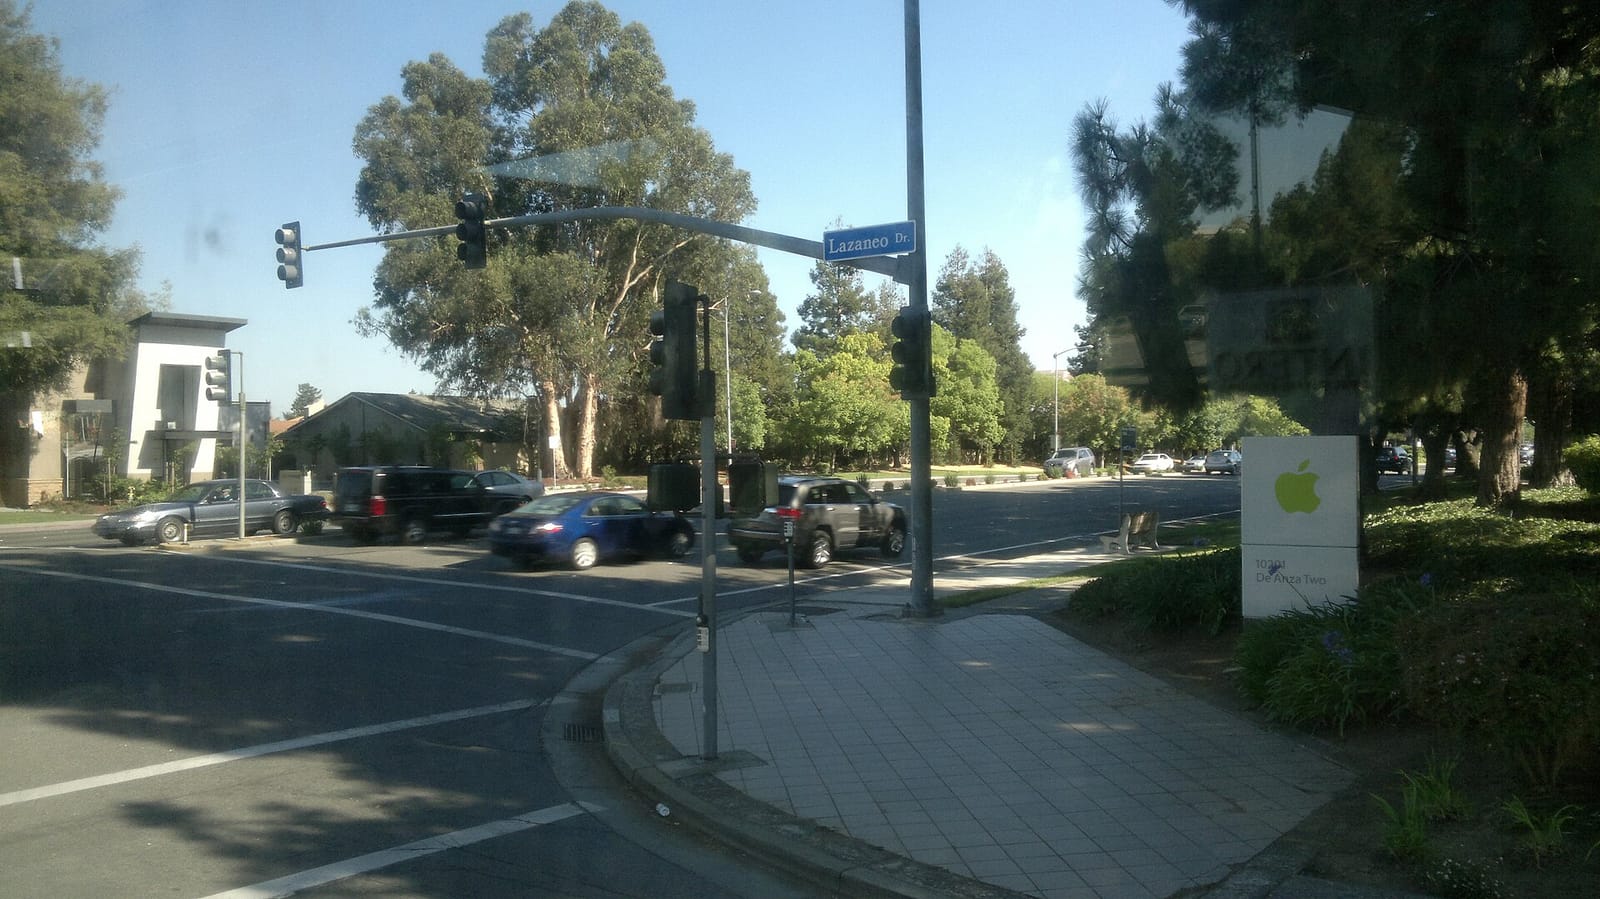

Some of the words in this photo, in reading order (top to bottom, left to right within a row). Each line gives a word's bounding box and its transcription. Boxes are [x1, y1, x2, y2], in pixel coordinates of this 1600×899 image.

[829, 236, 889, 254] Lazaneo
[895, 232, 911, 244] Dr.
[1256, 572, 1272, 583] De
[1273, 573, 1302, 584] Anza
[1303, 574, 1327, 585] Two
